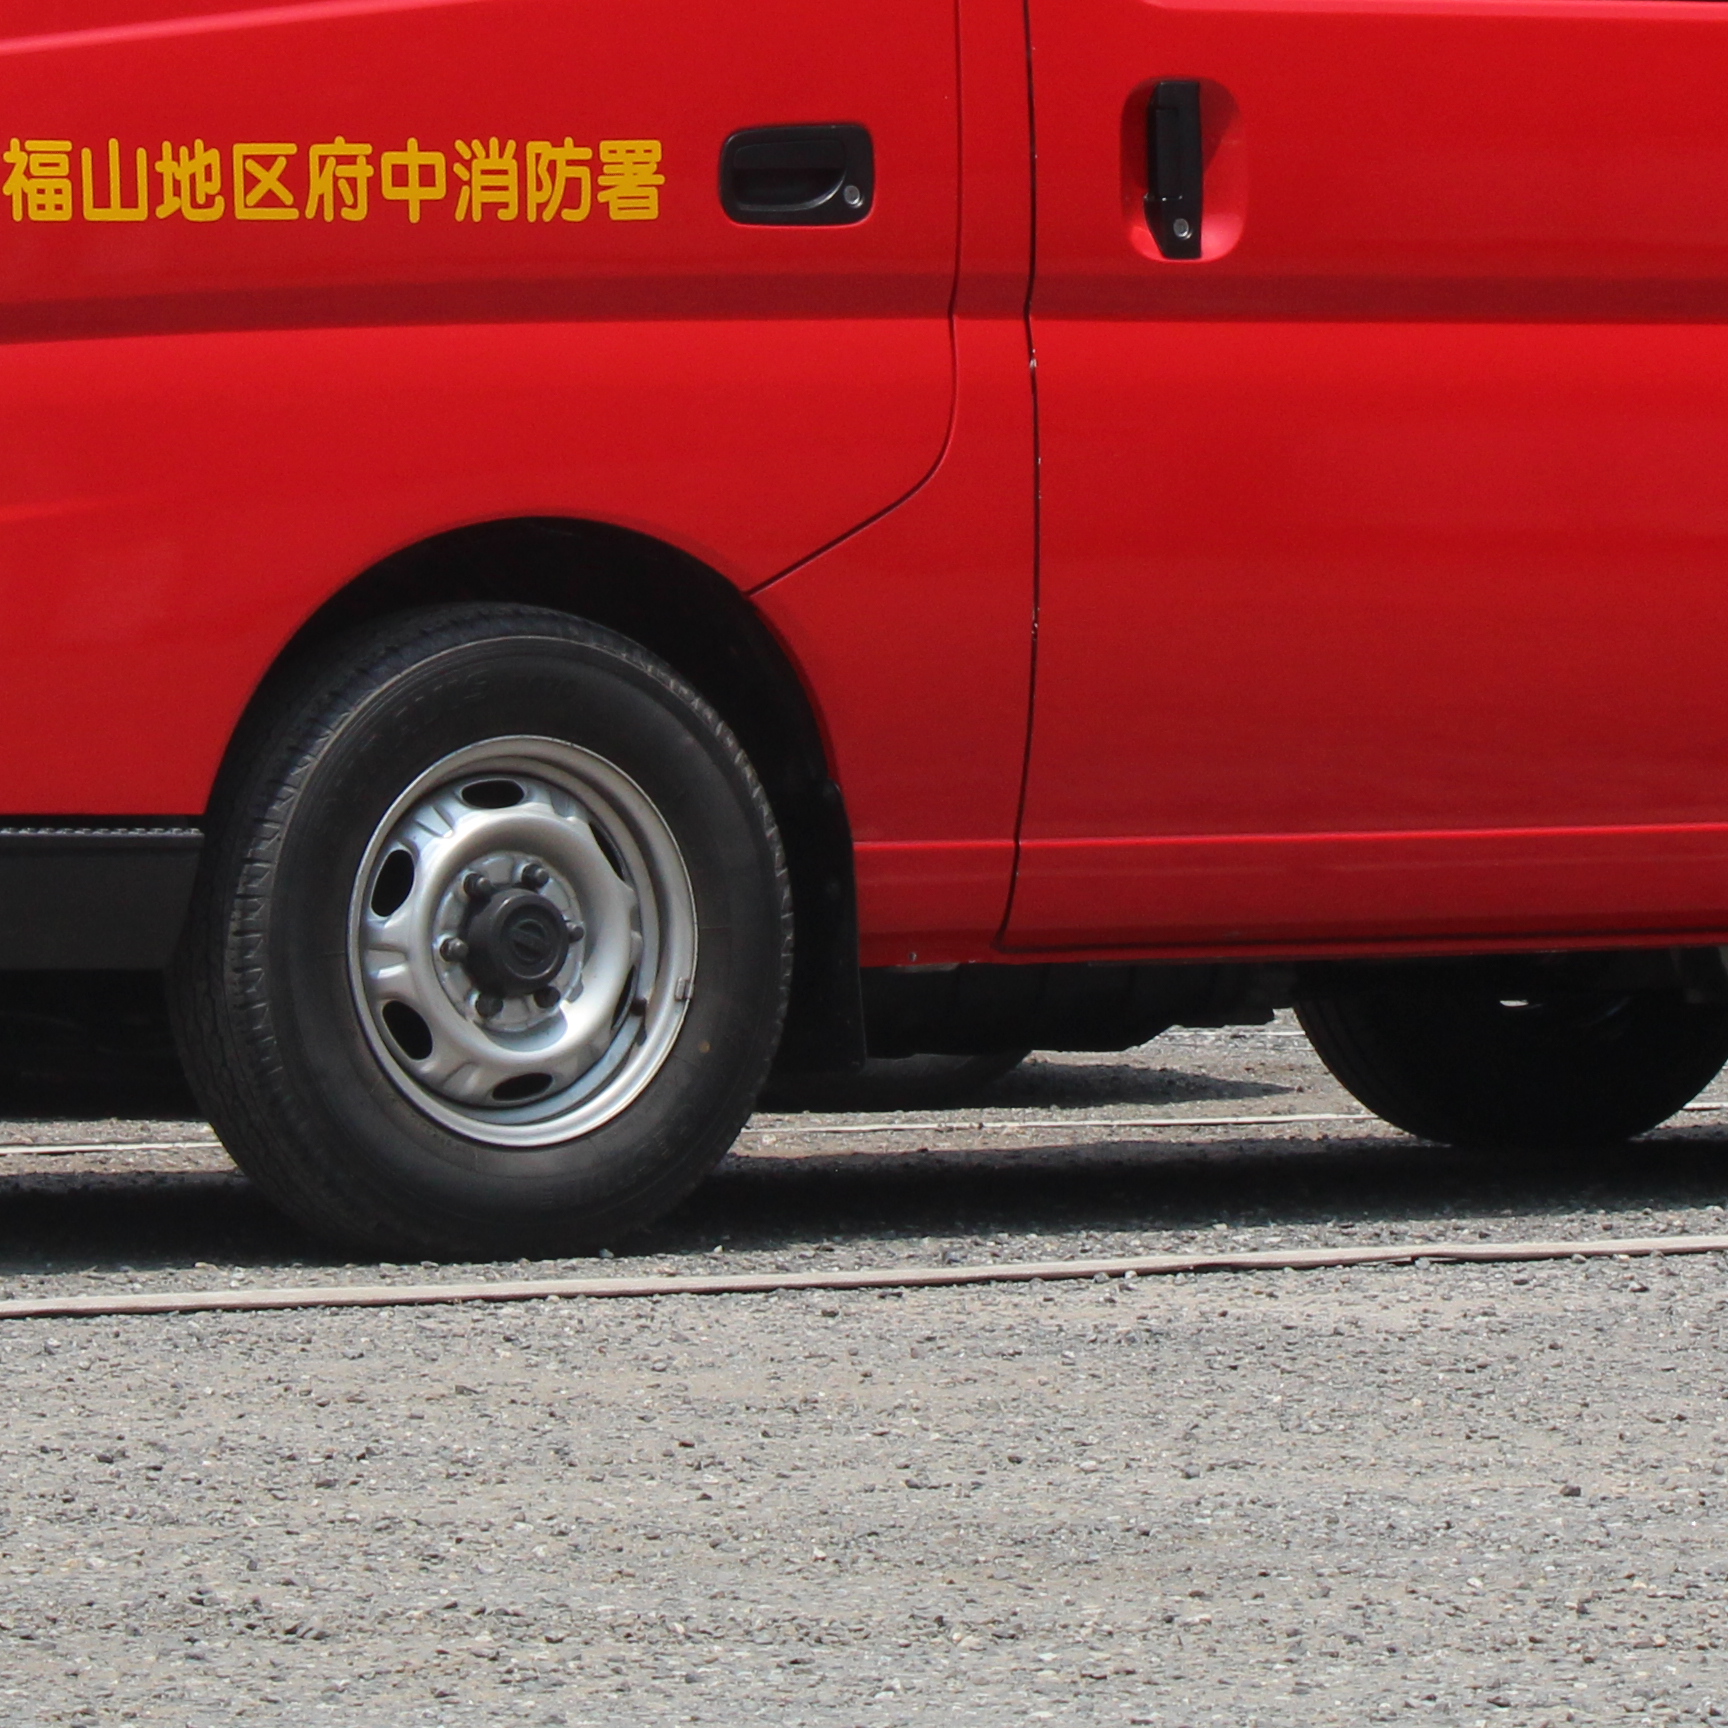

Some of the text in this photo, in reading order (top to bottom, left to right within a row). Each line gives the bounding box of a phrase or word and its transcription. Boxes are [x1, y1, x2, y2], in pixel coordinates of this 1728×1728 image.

[1, 136, 666, 224] 福山地区府中消防署
